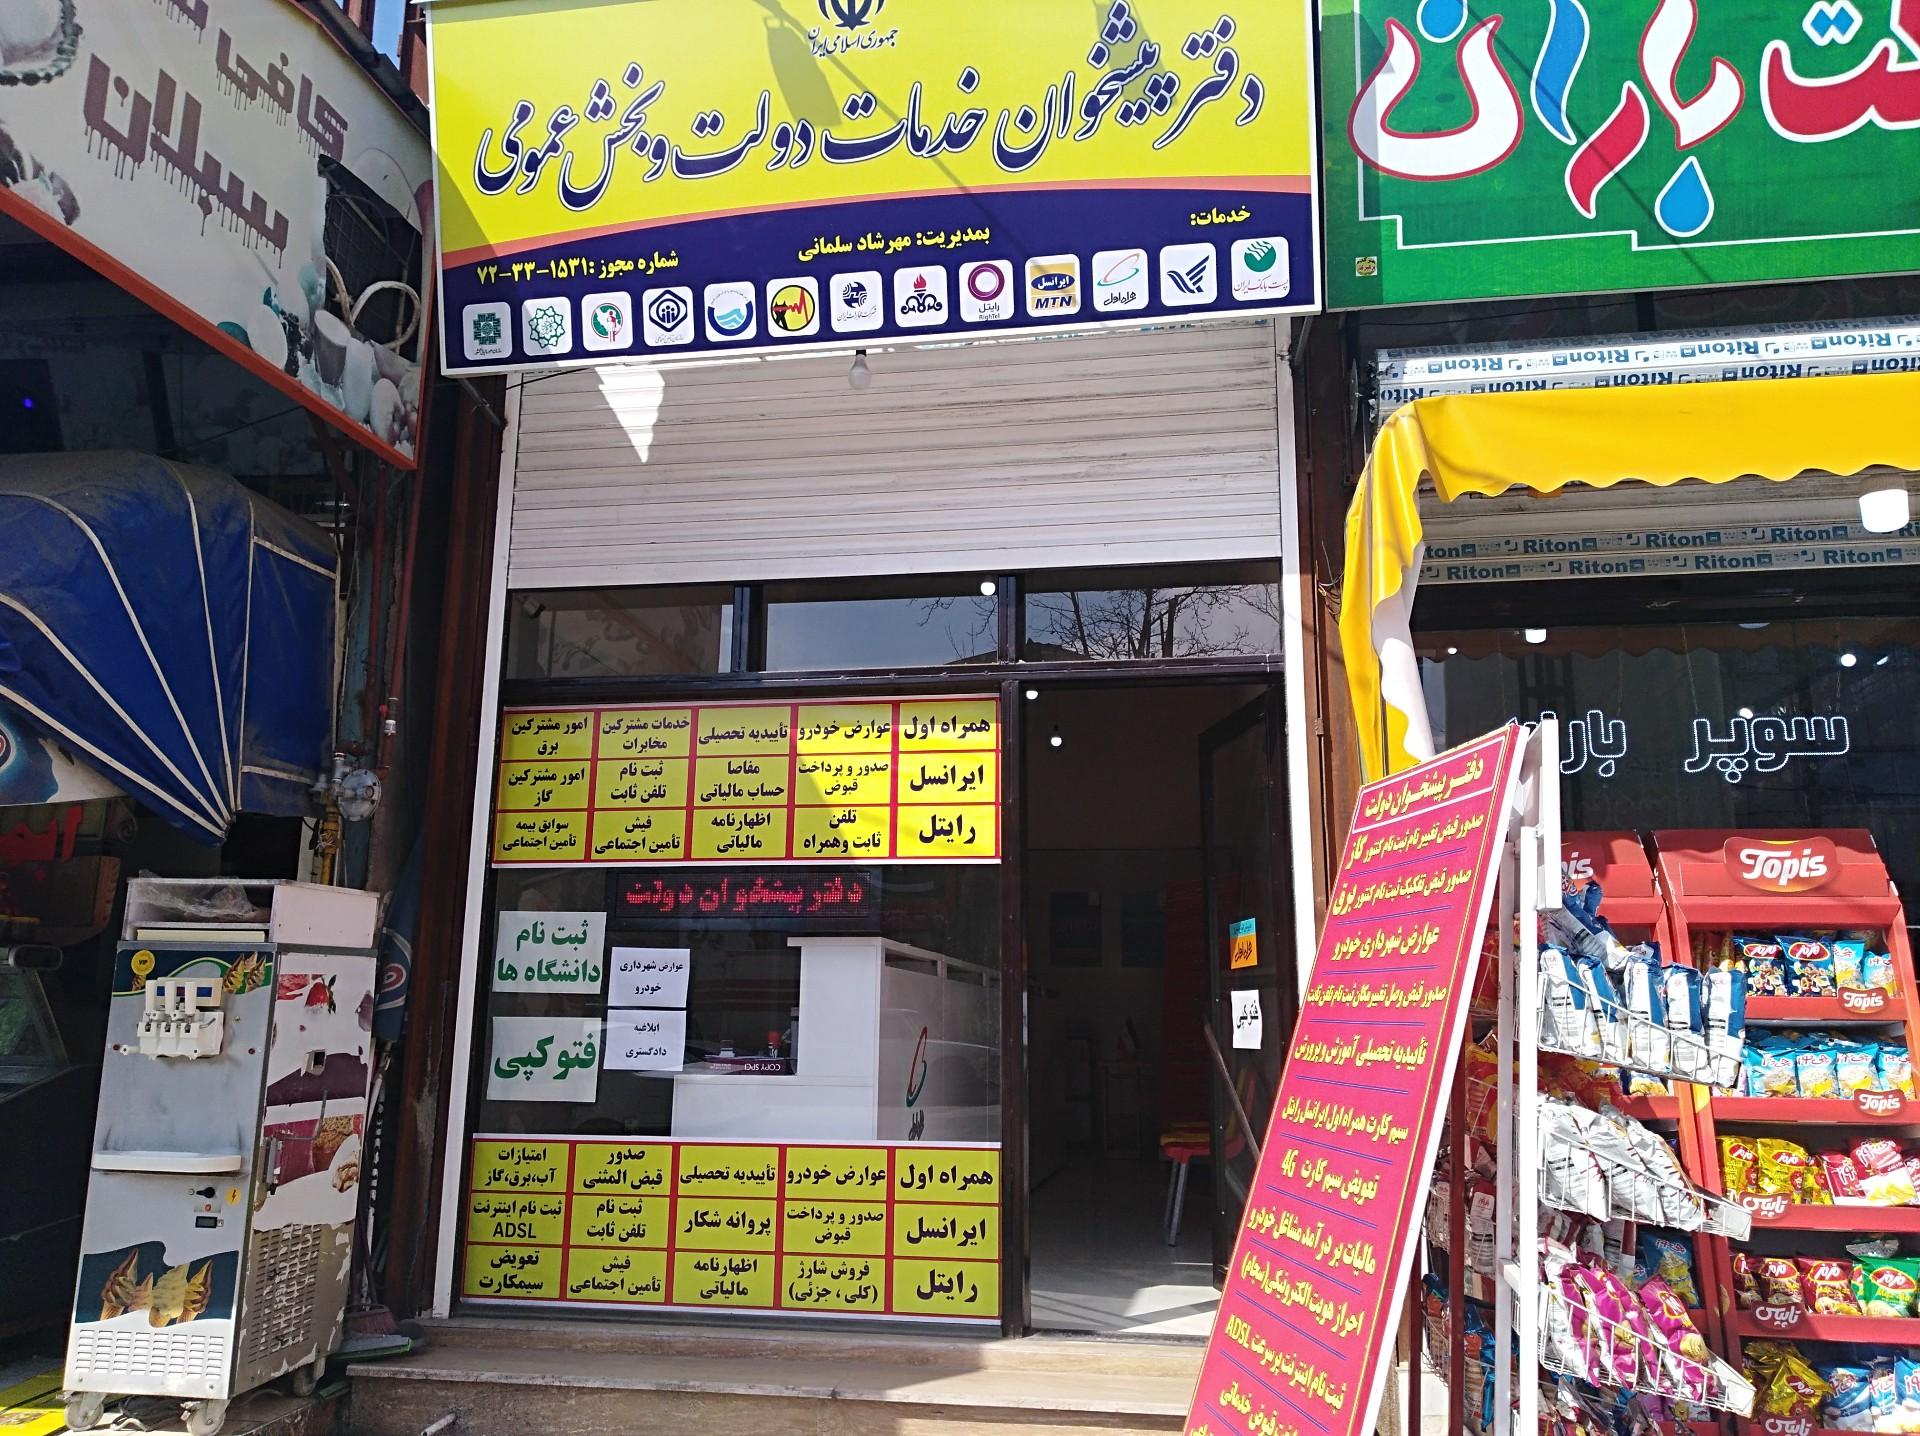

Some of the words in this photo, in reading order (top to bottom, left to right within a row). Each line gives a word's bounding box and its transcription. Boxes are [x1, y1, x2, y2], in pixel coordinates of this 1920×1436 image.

[807, 26, 828, 57] ایران
[860, 29, 898, 49] جمهوری
[993, 0, 1180, 172] پیشخوان
[1153, 15, 1264, 150] دفتر
[821, 67, 987, 163] خدمات
[558, 62, 665, 211] بخش
[671, 89, 815, 181] دولت
[474, 100, 579, 195] عمومی
[1190, 204, 1251, 226] خدمات:
[916, 226, 990, 248] بمدیریت:
[797, 236, 852, 262] سلمانی
[598, 257, 634, 279] مجوز
[637, 250, 679, 275] شماره
[1036, 275, 1071, 290] ایرانسل
[978, 302, 1000, 314] رایتل
[1034, 295, 1073, 309] MTN
[1698, 340, 1759, 355] Riton
[1829, 332, 1891, 347] Riton
[1445, 357, 1503, 372] Riton
[1570, 349, 1629, 365] Riton
[1742, 363, 1802, 379] Riton
[1523, 538, 1582, 554] Riton
[1646, 531, 1705, 548] Riton
[1771, 526, 1832, 542] Riton
[1447, 564, 1506, 580] Riton
[1569, 560, 1629, 576] Riton
[1695, 554, 1757, 570] Riton
[1824, 548, 1885, 565] Riton
[511, 717, 560, 736] مشترکین
[563, 716, 588, 735] امور
[602, 717, 649, 735] مشترکین
[652, 715, 690, 730] خدمات
[749, 722, 789, 743] تأییدیه
[798, 720, 841, 741] خودرو
[844, 719, 891, 739] عوارض
[903, 714, 936, 740] اول
[940, 715, 991, 736] همراه
[622, 736, 668, 754] مخابرات
[698, 726, 746, 745] تحصیلی
[537, 740, 559, 756] برق
[1685, 716, 1850, 783] سوپر
[508, 768, 558, 786] مشترکین
[560, 767, 585, 786] امور
[620, 762, 638, 781] نام
[641, 760, 664, 780] ثبت
[727, 760, 761, 775] مفاصا
[798, 760, 844, 778] پرداخت
[847, 765, 853, 777] و
[856, 761, 890, 777] صدور
[1442, 752, 1484, 800] دفتر
[824, 779, 859, 796] قبوض
[909, 765, 985, 793] ایرانسل
[534, 789, 553, 807] گاز
[611, 783, 638, 803] ثابت
[640, 784, 667, 803] تلفن
[700, 783, 744, 802] مالیاتی
[747, 782, 785, 801] حساب
[1390, 771, 1447, 816] پیشخوان
[1365, 790, 1393, 821] دولت
[515, 820, 536, 833] بیمه
[538, 818, 569, 834] سوابق
[624, 816, 652, 833] فیش
[711, 812, 771, 831] اظهارنامه
[829, 808, 857, 829] تلفن
[917, 814, 977, 846] رایتل
[502, 836, 547, 852] اجتماعی
[550, 833, 577, 850] تأمین
[594, 836, 646, 854] اجتماعی
[649, 834, 681, 853] تأمین
[716, 834, 763, 853] مالیاتی
[852, 831, 882, 852] ثابت
[1739, 848, 1828, 888] Topis
[626, 879, 694, 913] دولت
[699, 876, 804, 914] پیشخوان
[806, 876, 863, 912] دفتر
[516, 920, 545, 952] نام
[551, 919, 589, 951] ثبت
[1360, 926, 1402, 959] شهرداری
[1400, 921, 1440, 955] عوارض
[1331, 931, 1361, 961] خودرو
[497, 958, 518, 982] ها
[524, 958, 601, 983] دانشگاه
[619, 960, 657, 973] شهرداری
[658, 961, 684, 973] عوارض
[634, 982, 662, 995] خودرو
[1843, 989, 1885, 1012] Topis
[633, 1022, 660, 1035] ابلاغیه
[625, 1048, 667, 1059] دادگستری
[1294, 1034, 1322, 1063] پرورش
[1325, 1034, 1361, 1066] آموزش
[1356, 1037, 1396, 1067] تحصیلی
[1859, 1093, 1901, 1114] Topis
[498, 1147, 547, 1165] امتیازات
[607, 1147, 646, 1165] صدور
[1281, 1149, 1299, 1178] 4G
[583, 1169, 627, 1189] المثنی
[630, 1169, 663, 1190] قبض
[680, 1165, 731, 1184] تحصیلی
[733, 1164, 776, 1185] تأییدیه
[786, 1164, 832, 1186] خودرو
[835, 1165, 887, 1186] عوارض
[899, 1165, 934, 1189] اول
[940, 1167, 994, 1190] همراه
[1301, 1158, 1328, 1188] کارت
[1322, 1173, 1343, 1194] سیم
[1341, 1169, 1380, 1206] تعویض
[473, 1200, 517, 1218] اینترنت
[518, 1200, 538, 1218] نام
[539, 1199, 563, 1219] ثبت
[596, 1199, 615, 1218] نام
[618, 1198, 643, 1220] ثبت
[786, 1206, 835, 1225] پرداخت
[849, 1208, 884, 1226] صدور
[683, 1209, 722, 1233] شکار
[725, 1209, 771, 1237] پروانه
[838, 1213, 845, 1225] و
[493, 1222, 537, 1239] ADSL
[586, 1221, 616, 1241] ثابت
[618, 1222, 647, 1242] تلفن
[814, 1228, 851, 1245] قبوض
[906, 1215, 986, 1245] ایرانسل
[490, 1249, 540, 1270] تعویض
[602, 1255, 631, 1274] فیش
[693, 1257, 758, 1276] اظهارنامه
[797, 1261, 827, 1279] شارژ
[830, 1261, 870, 1281] فروش
[479, 1273, 544, 1294] سیمکارت
[570, 1277, 624, 1295] اجتماعی
[627, 1276, 662, 1296] تأمین
[699, 1280, 749, 1299] مالیاتی
[916, 1268, 978, 1302] رایتل
